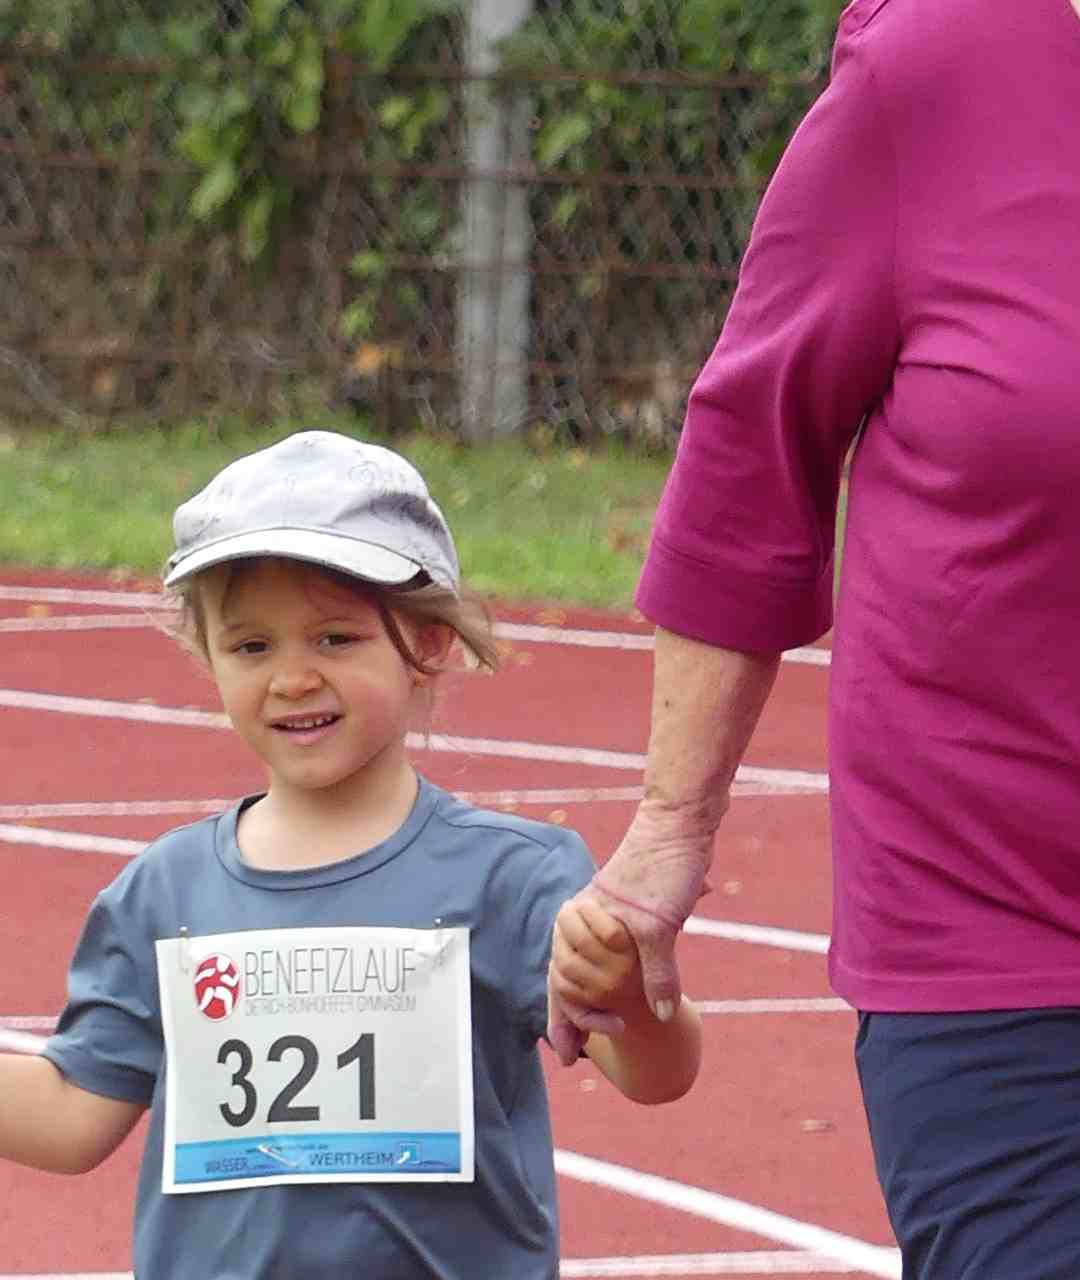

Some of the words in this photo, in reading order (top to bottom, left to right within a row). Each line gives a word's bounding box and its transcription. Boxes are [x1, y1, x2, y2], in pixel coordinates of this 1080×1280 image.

[244, 946, 416, 998] BENEFIZLAUF
[216, 1032, 377, 1128] 321
[309, 1150, 394, 1168] WERTHEIM
